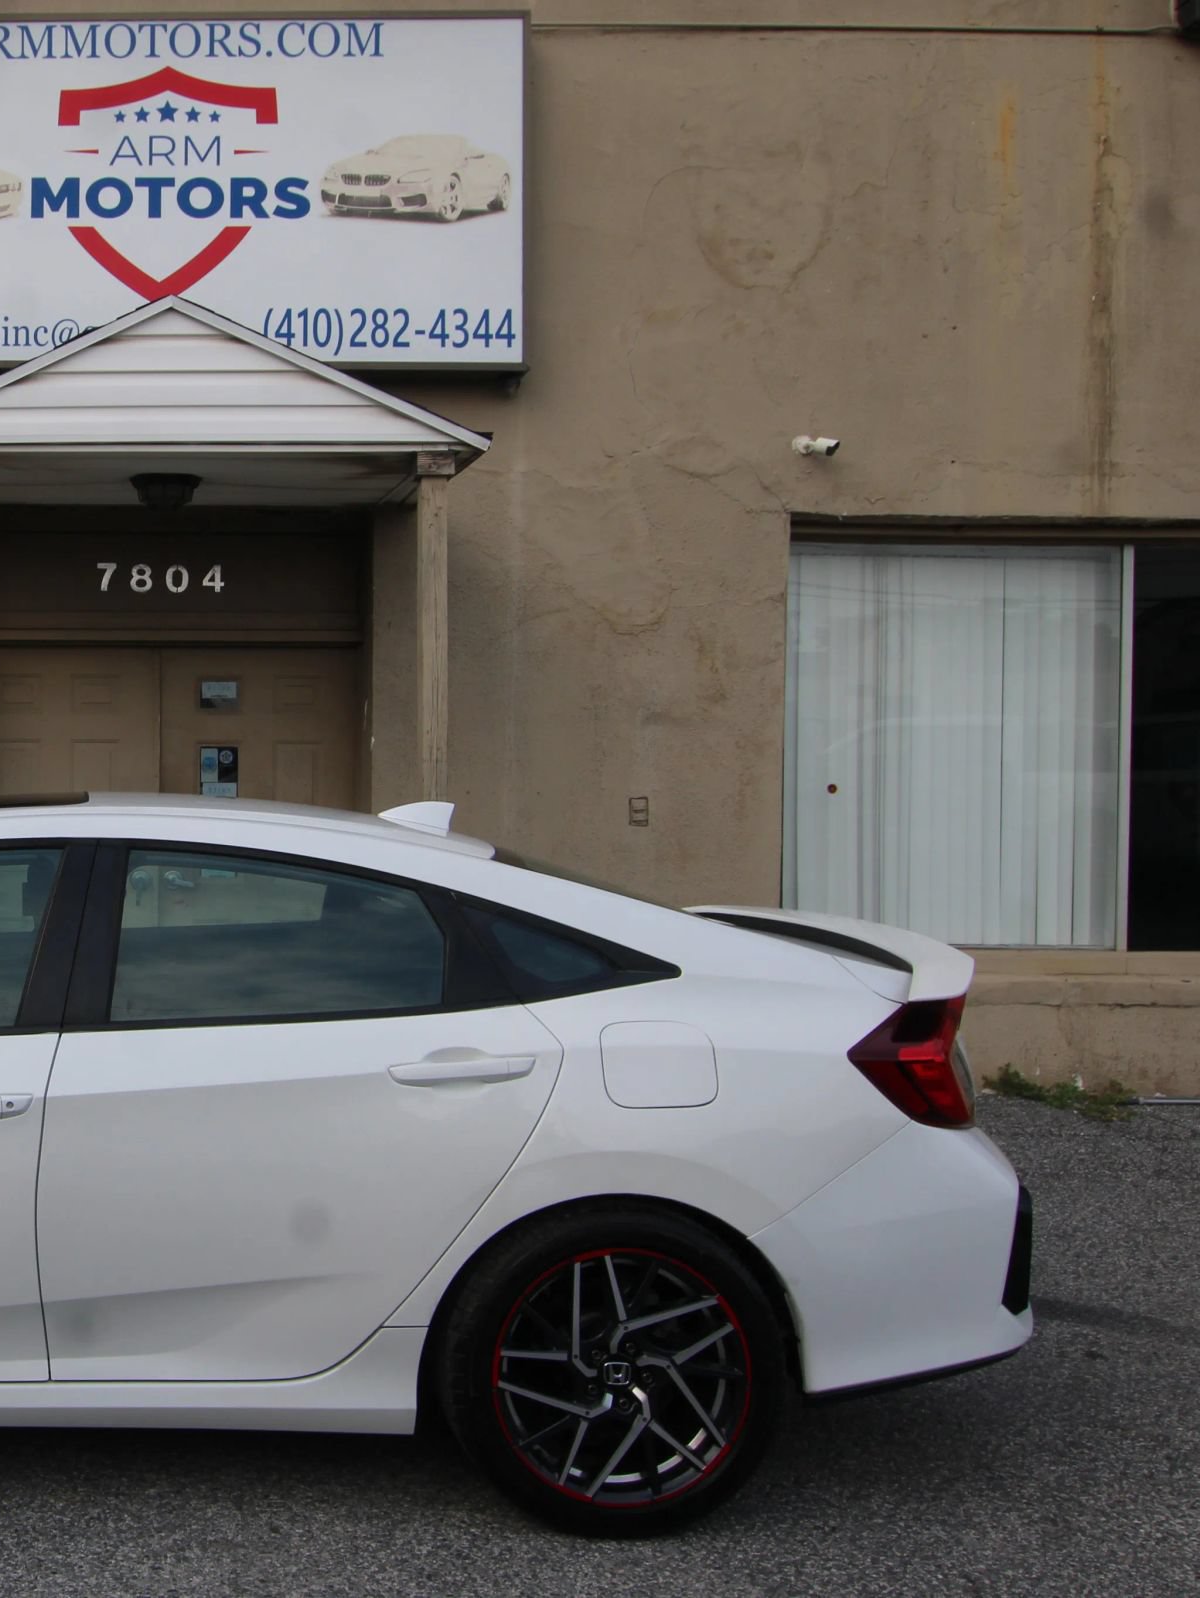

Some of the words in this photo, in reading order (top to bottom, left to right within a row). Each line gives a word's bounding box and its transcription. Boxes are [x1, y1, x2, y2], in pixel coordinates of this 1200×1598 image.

[109, 135, 222, 166] ARM
[30, 176, 311, 220] MOTORS
[96, 562, 225, 593] 7804
